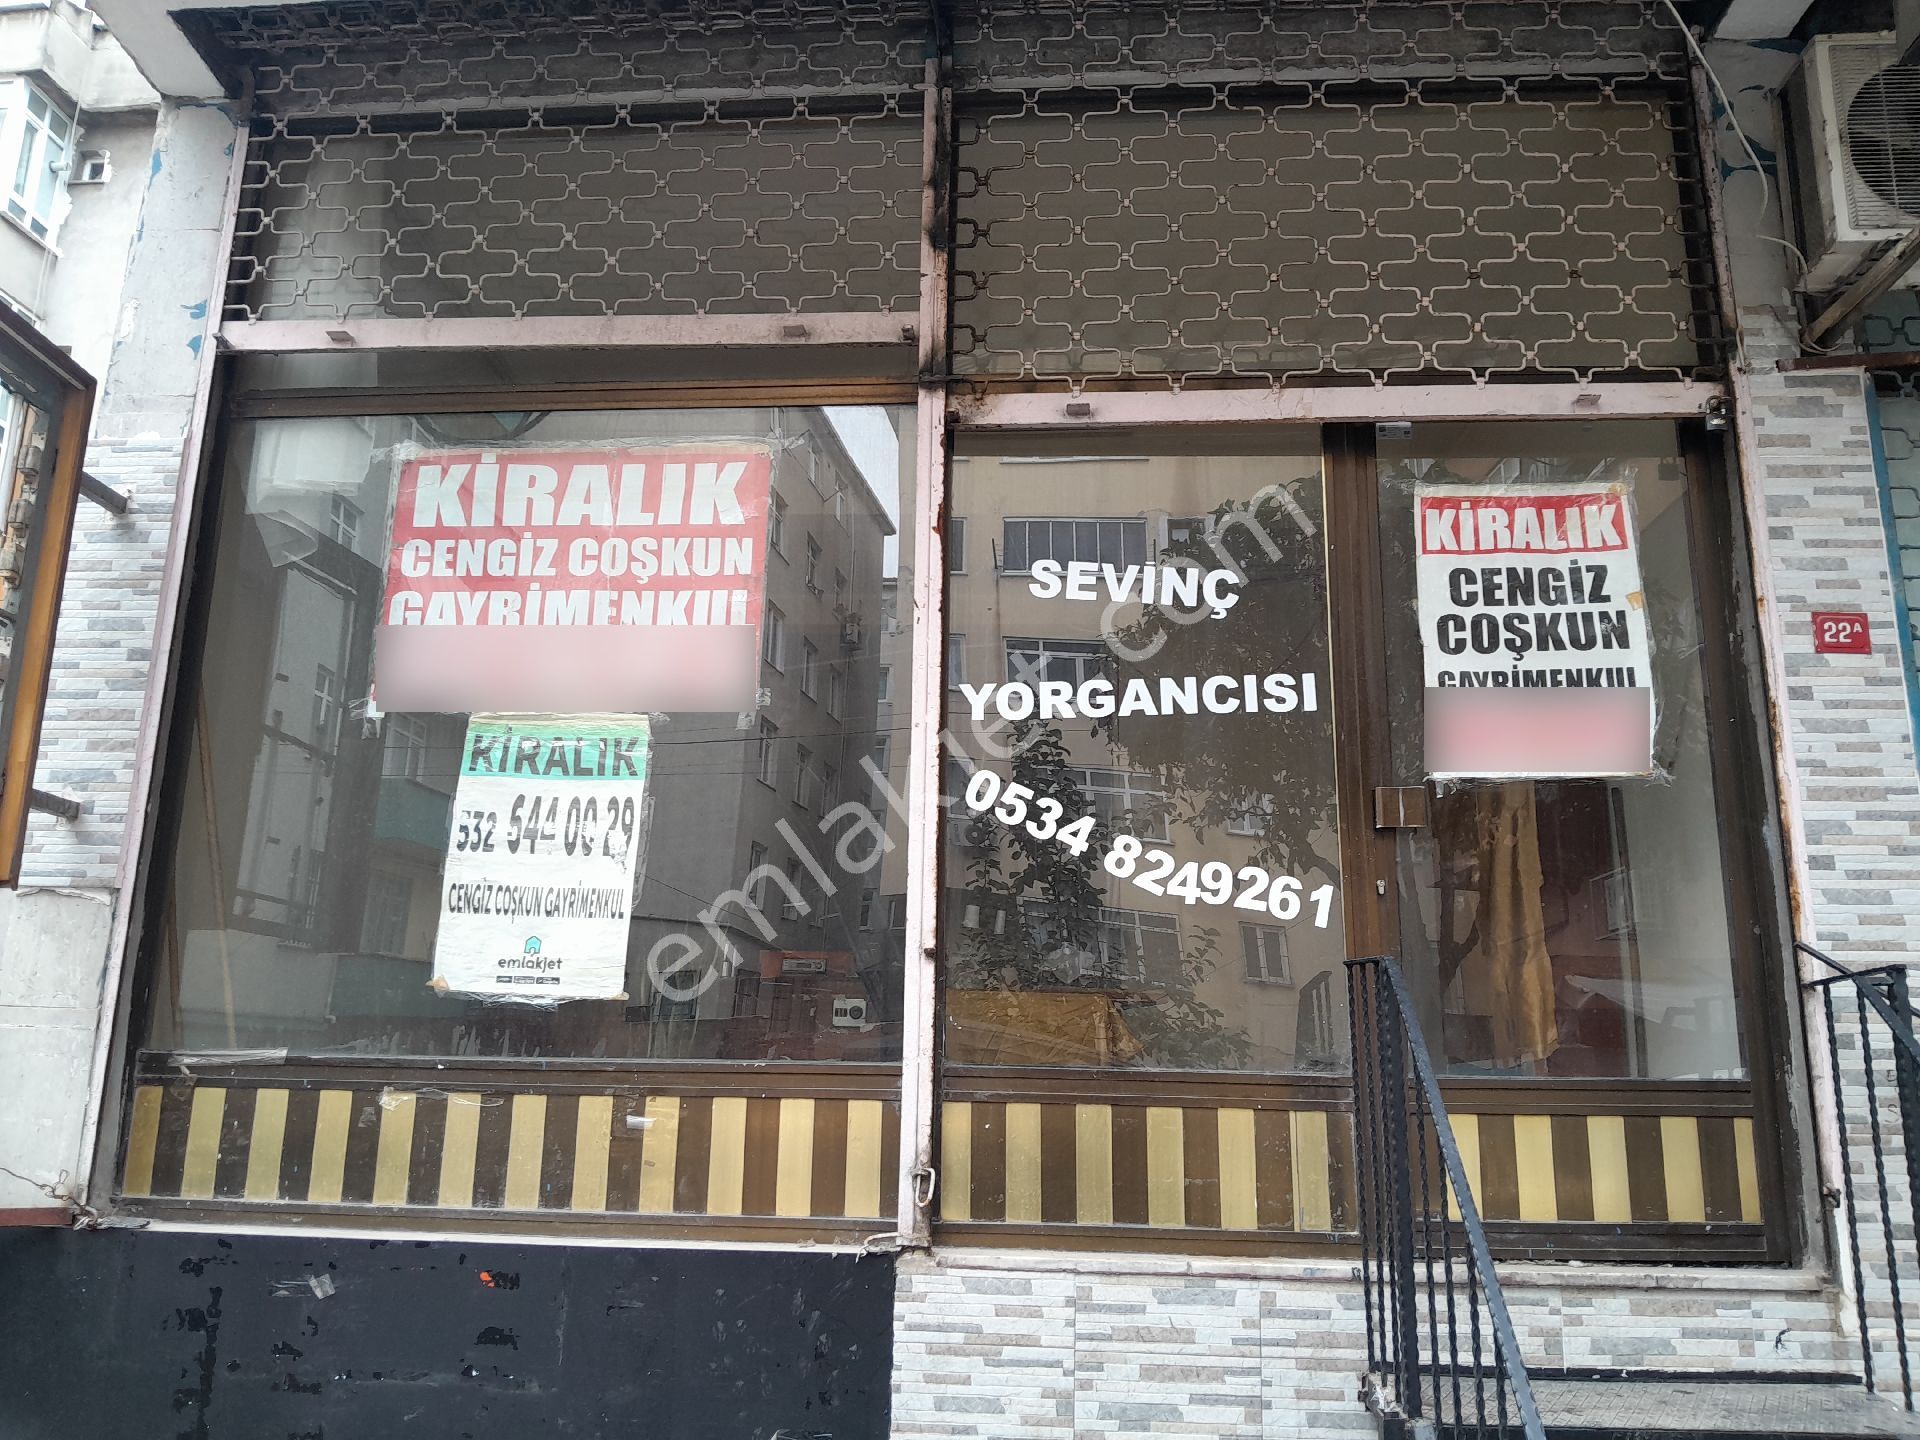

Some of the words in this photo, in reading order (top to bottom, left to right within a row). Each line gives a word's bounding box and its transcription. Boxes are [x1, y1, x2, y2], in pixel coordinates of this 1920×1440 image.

[412, 453, 748, 528] KİRALIK
[1425, 501, 1624, 551] KİRALIK
[401, 531, 559, 578] CENGİZ
[568, 536, 753, 585] COŞKUN
[1449, 558, 1612, 608] CENGİZ
[1028, 559, 1240, 620] SEVİNÇ
[1436, 609, 1631, 662] COŞKUN
[958, 673, 1318, 721] YORGANCISI
[468, 725, 639, 777] KİRALIK
[964, 769, 1097, 857] 0534
[1103, 835, 1335, 929] 8249261
[448, 876, 494, 915] CENGİZ
[494, 884, 544, 924] COŞKUN
[544, 880, 625, 919] GAYRİMENKUL
[497, 955, 563, 974] emlakjet
